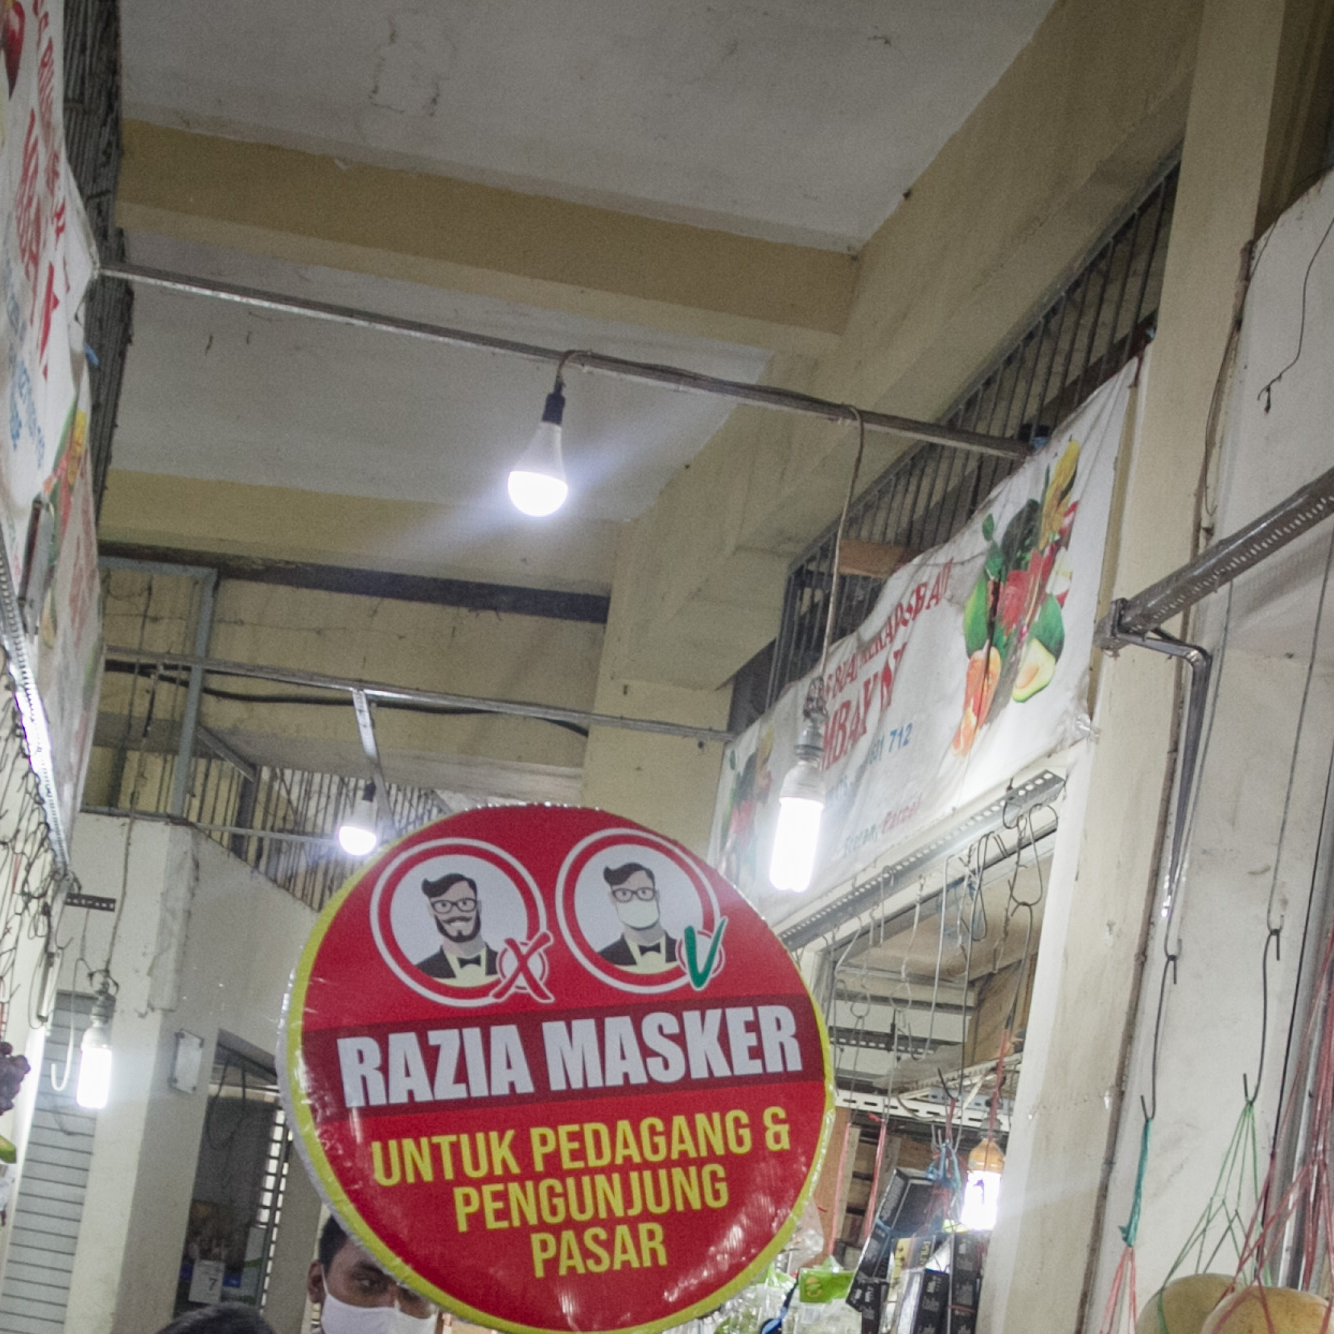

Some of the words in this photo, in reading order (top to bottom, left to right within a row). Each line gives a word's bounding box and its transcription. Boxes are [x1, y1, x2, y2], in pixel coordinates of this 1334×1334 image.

[888, 722, 914, 753] 712
[336, 1024, 535, 1109] RAZIA
[542, 1004, 803, 1092] MASKER
[370, 1128, 516, 1187] UNTUK
[531, 1108, 752, 1174] PEDAGANG
[764, 1105, 791, 1152] &
[453, 1163, 729, 1233] PENGUNJUNG
[531, 1222, 667, 1279] PASAR
